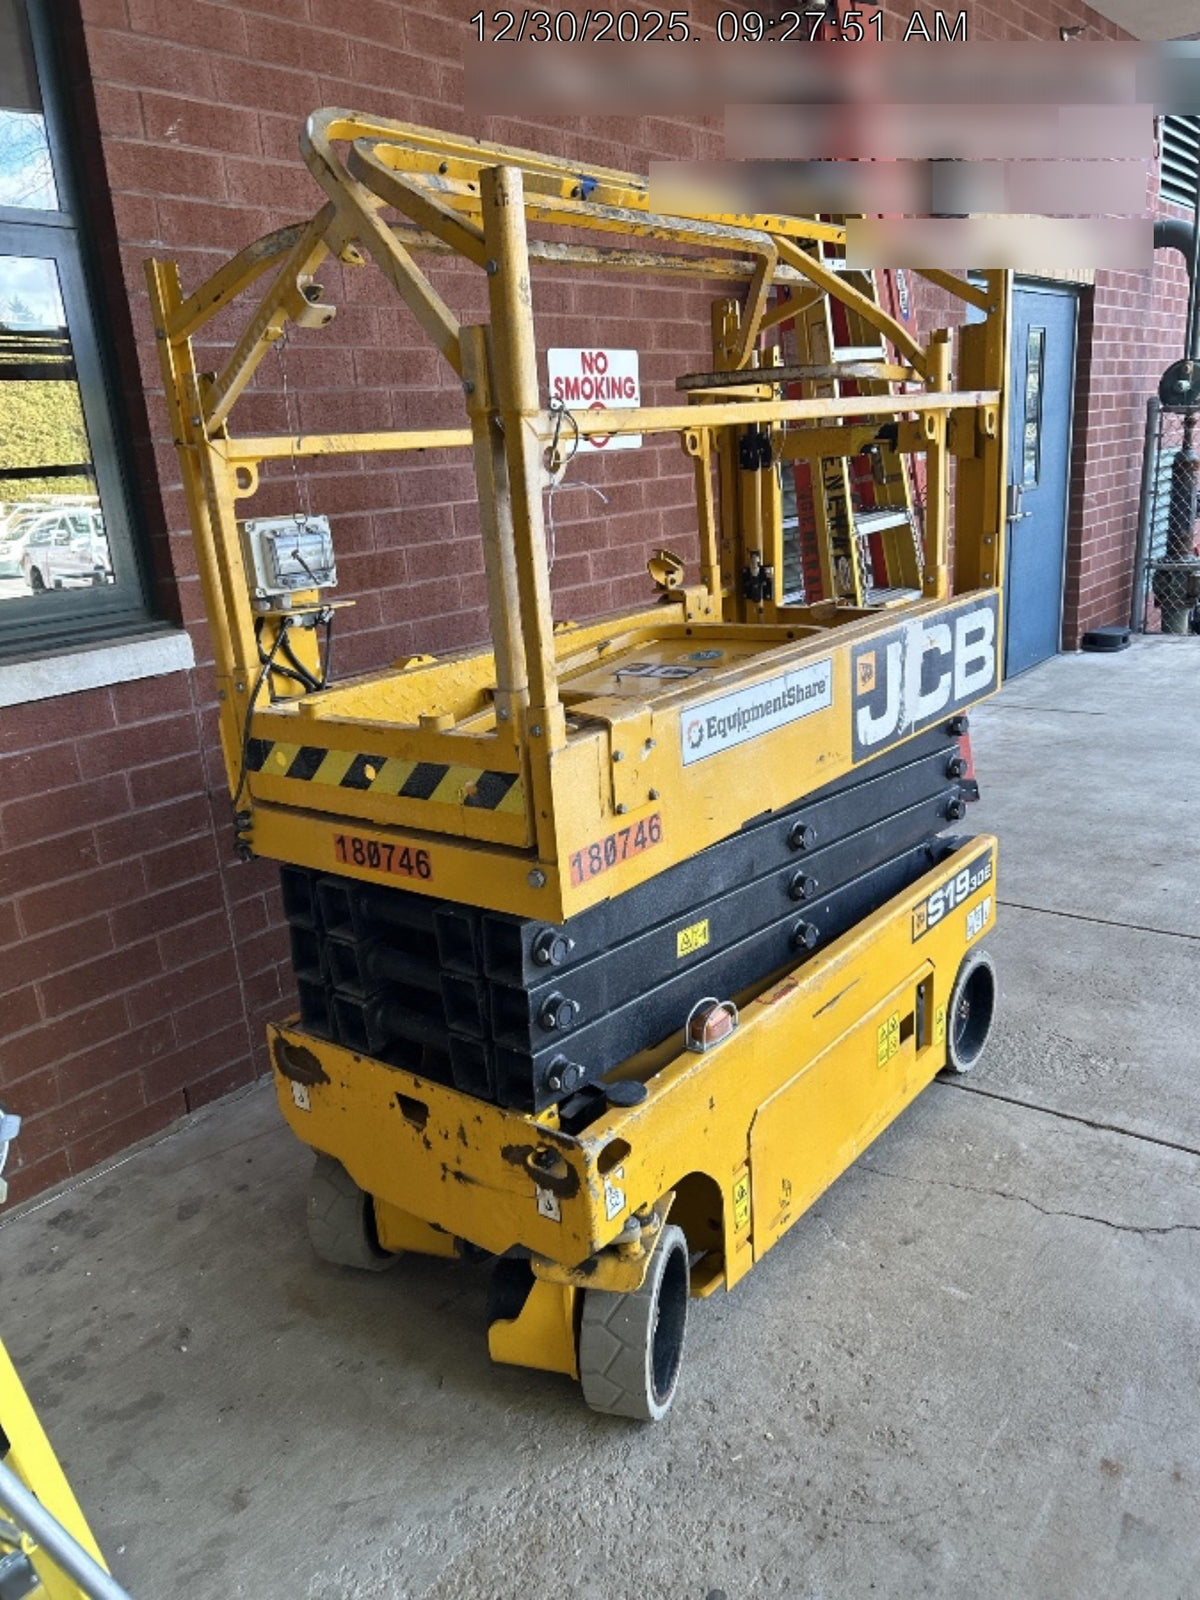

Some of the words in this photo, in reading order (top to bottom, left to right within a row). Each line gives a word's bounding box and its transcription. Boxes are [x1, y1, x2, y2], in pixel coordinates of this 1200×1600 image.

[554, 376, 635, 400] SMOKING
[581, 352, 608, 375] NO
[857, 607, 995, 746] JCB
[705, 677, 826, 740] EquipmentShare
[336, 835, 432, 880] 180746
[571, 813, 662, 883] 180746
